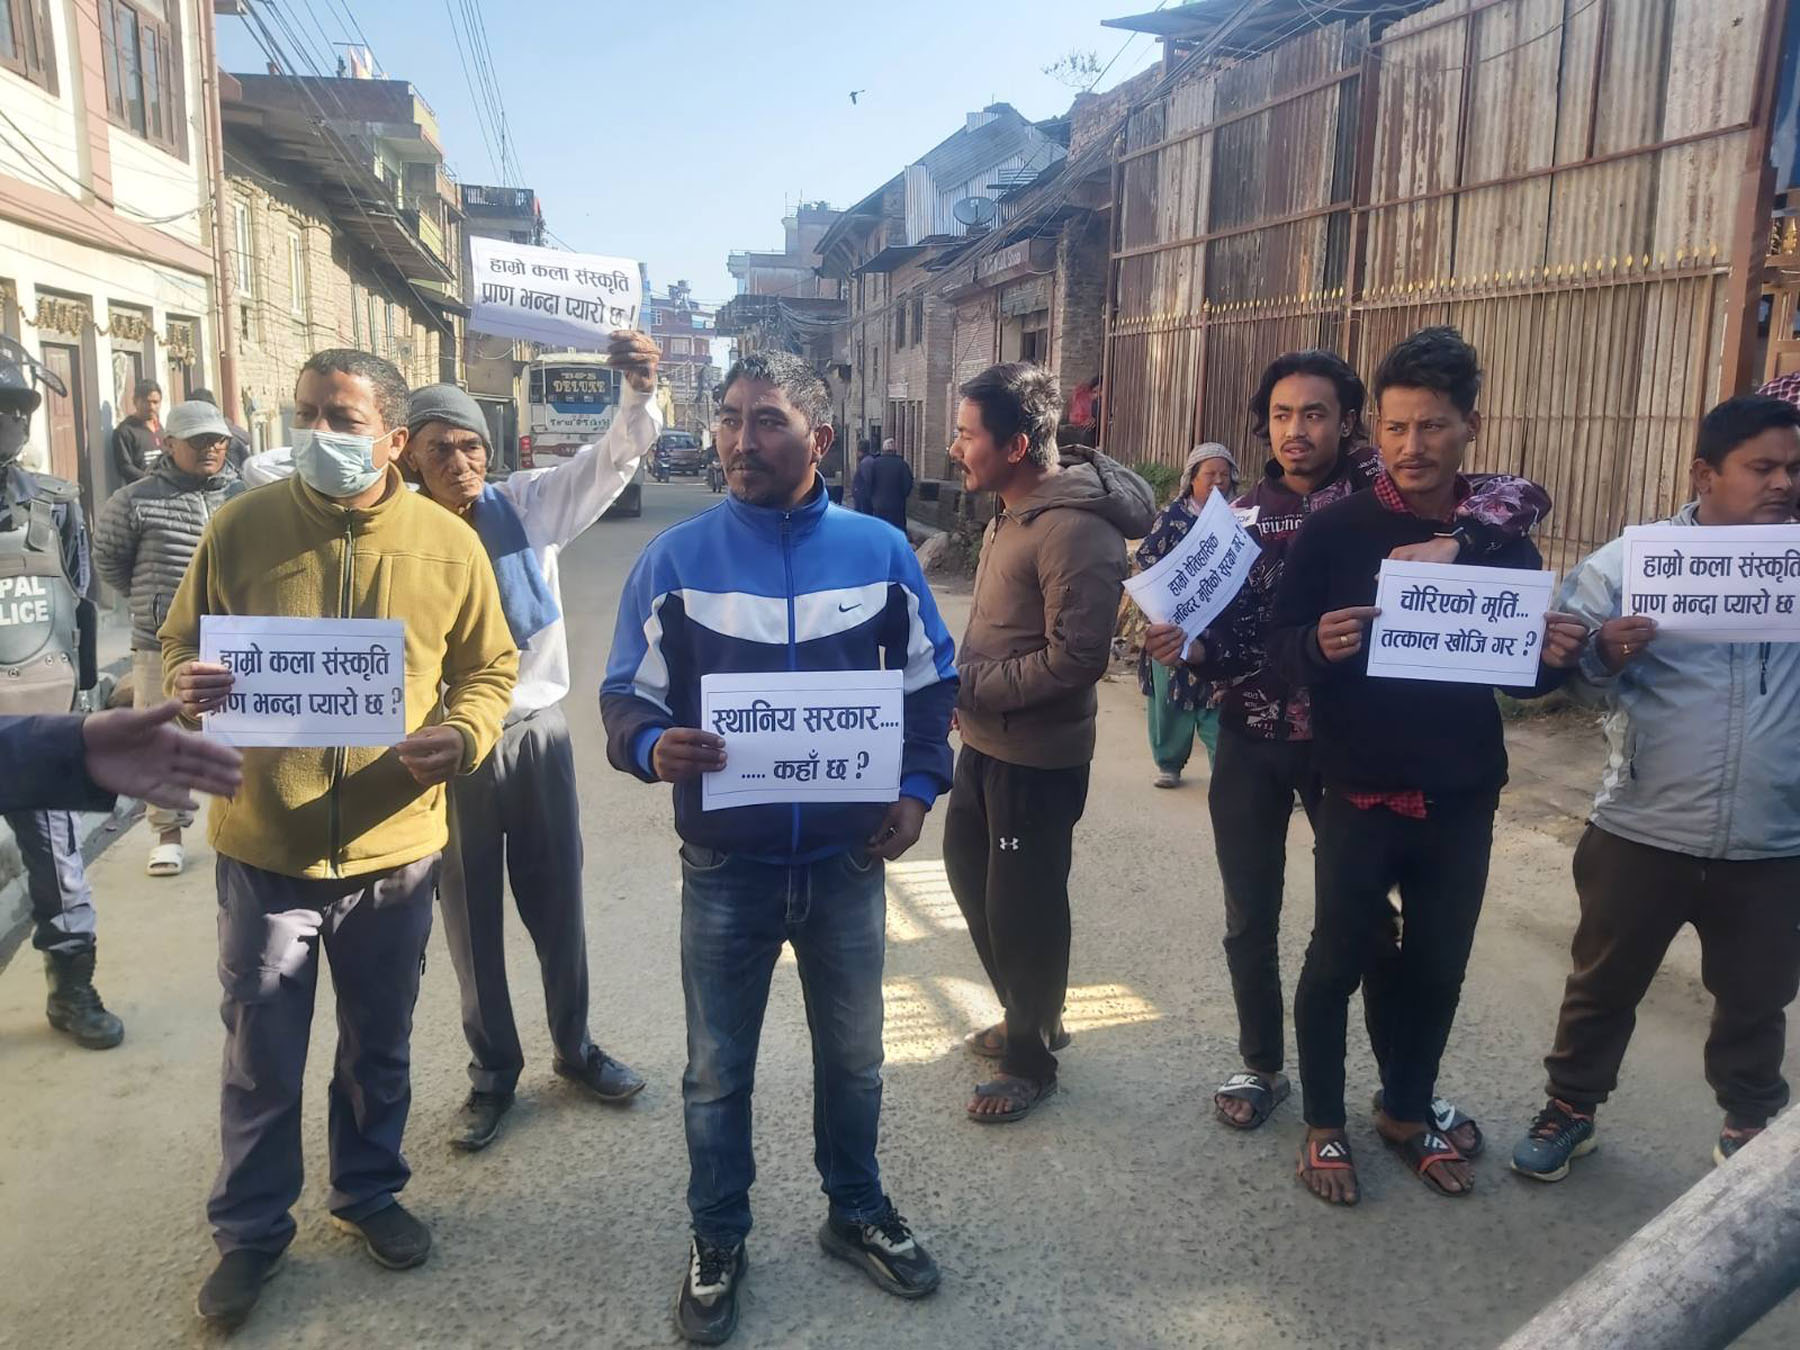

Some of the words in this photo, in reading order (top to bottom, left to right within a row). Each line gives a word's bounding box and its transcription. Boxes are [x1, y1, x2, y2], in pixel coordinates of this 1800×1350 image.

[490, 258, 526, 276] हाम्रो
[532, 263, 569, 282] कला
[575, 268, 630, 295] संस्कृति
[482, 282, 514, 306] प्राण
[520, 288, 560, 315] भन्दा
[566, 296, 605, 324] प्यारो
[609, 306, 625, 326] छ
[553, 380, 605, 392] DELUXE
[1167, 570, 1190, 597] हाम्रो
[1184, 532, 1220, 577] ऐतिहासिक
[1643, 549, 1684, 579] हाम्रो
[1689, 556, 1734, 577] कला
[1738, 549, 1800, 583] संस्कृति
[1195, 570, 1223, 603] मूर्तिको
[1400, 584, 1478, 615] चोरिएको
[1631, 593, 1668, 615] प्राण
[1672, 594, 1718, 616] भन्दा
[1723, 588, 1771, 615] प्यारो
[1775, 594, 1796, 614] छ
[1381, 629, 1441, 650] तत्काल
[1444, 628, 1489, 654] खोजि
[1491, 636, 1518, 656] गर
[1522, 630, 1538, 657] ?
[219, 642, 263, 677] हाम्रो
[269, 651, 315, 675] कला
[322, 643, 391, 681] संस्कृति
[253, 693, 302, 717] भन्दा
[309, 686, 358, 717] प्यारो
[365, 693, 384, 716] छ
[712, 699, 797, 735] स्थानिय
[773, 749, 820, 782] कहाँ
[826, 758, 849, 780] छ
[855, 750, 870, 780] ?
